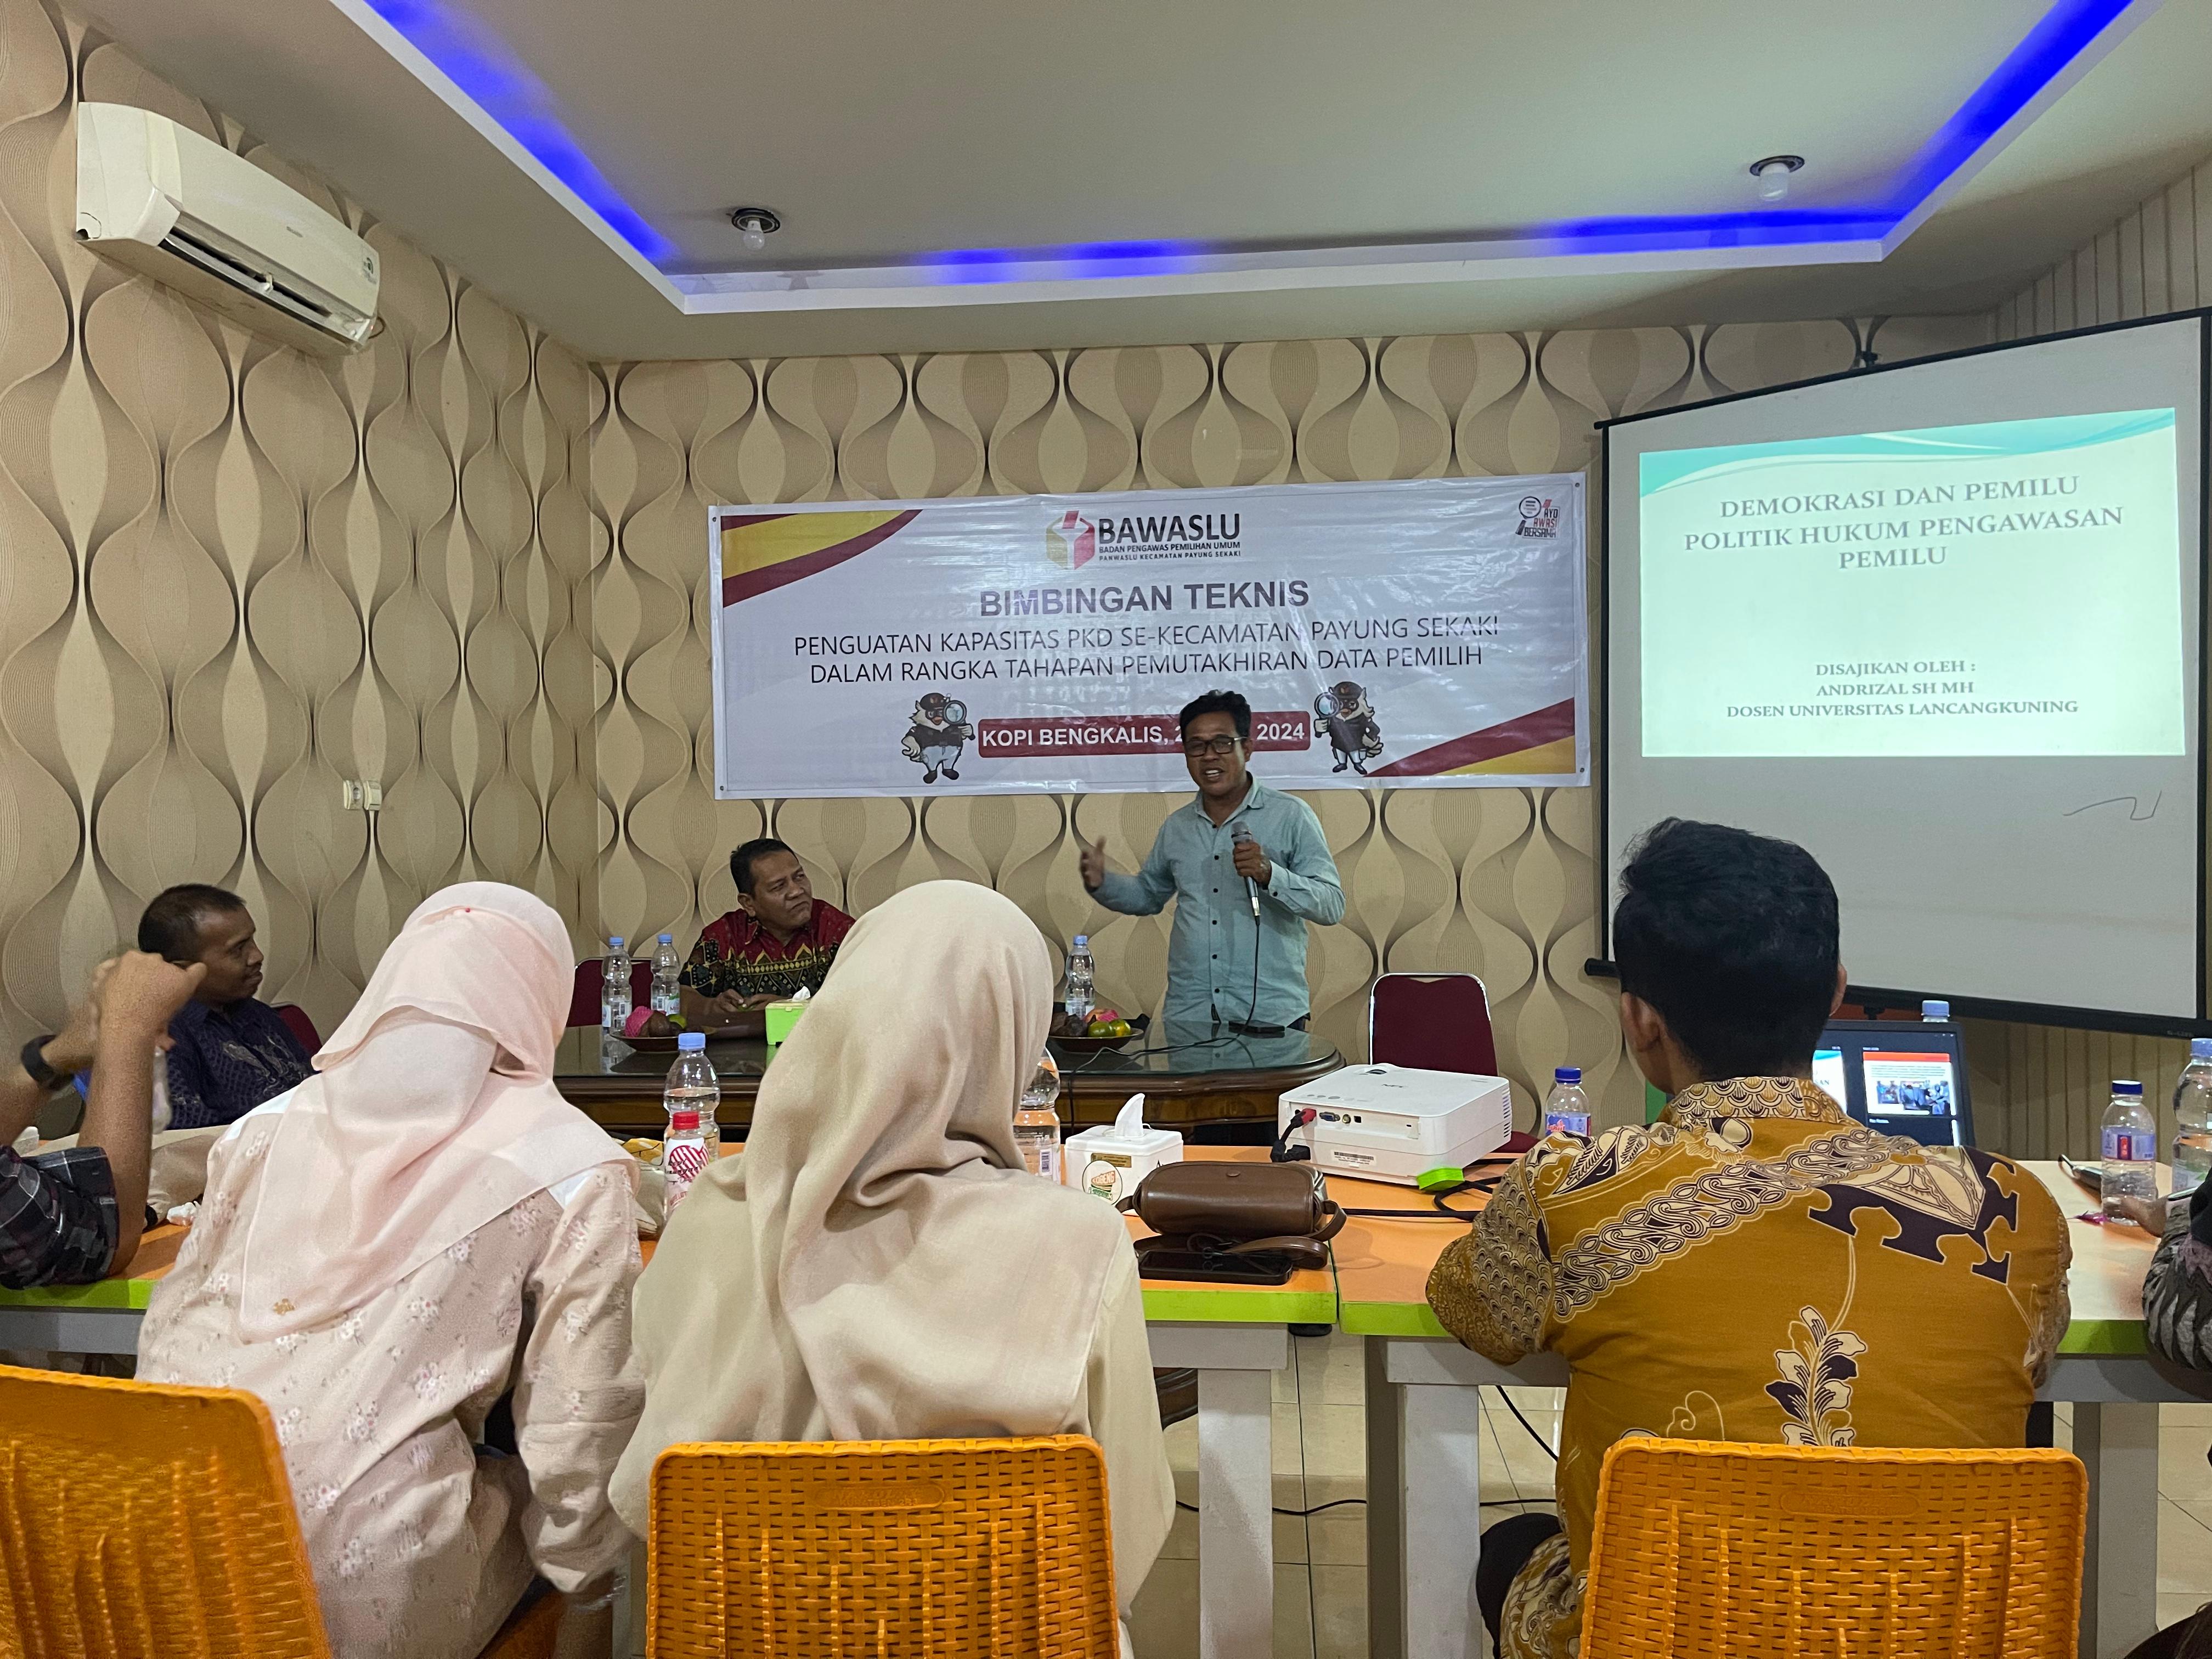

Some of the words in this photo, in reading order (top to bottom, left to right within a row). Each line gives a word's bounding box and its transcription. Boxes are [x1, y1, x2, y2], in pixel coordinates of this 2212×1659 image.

[1720, 489, 1886, 517] DEMOKRASI
[1895, 485, 1955, 506] DAN
[1963, 475, 2080, 501] PEMILU
[1533, 517, 1558, 528] AWASI
[1544, 509, 1558, 518] AYO
[1099, 513, 1240, 544] BAWASLU
[1684, 528, 1792, 550] POLITIK
[1799, 521, 1910, 544] HUKUM
[1919, 506, 2123, 537] PENGAWASAN
[1127, 544, 1169, 552] PENGAWAS
[1170, 542, 1212, 550] PEMILIHAN
[1839, 546, 1948, 569] PEMILU
[980, 585, 1172, 617] BIMBINGAN
[1183, 580, 1310, 610] TEKNIS
[795, 633, 931, 656] PENGUATAN
[941, 630, 1059, 652] KAPASITAS
[1068, 628, 1113, 648] PKD
[1121, 622, 1301, 647] SE-KECAMATAN
[1312, 619, 1408, 641] PAYUNG
[1417, 616, 1498, 637] SEKAKI
[811, 663, 892, 684] DALAM
[901, 660, 998, 681] RANGKA
[1005, 656, 1113, 679] TAHAPAN
[1122, 651, 1308, 675] PEMUTAKHIRAN
[1318, 648, 1378, 669] DATA
[1387, 645, 1482, 667] PEMILIH
[1816, 662, 1909, 677] DISAJIKAN
[1913, 661, 1966, 673] OLEH
[1815, 683, 1909, 696] ANDRIZAL
[1912, 682, 1937, 694] SH
[1942, 681, 1974, 693] MH
[1726, 706, 1785, 717] DOSEN
[1789, 703, 1904, 716] UNIVERSITAS
[1909, 700, 2079, 715] LANCANGKUNING
[983, 729, 1032, 747] KOPI
[1040, 726, 1169, 746] BENGKALIS,
[1257, 722, 1305, 741] 2024
